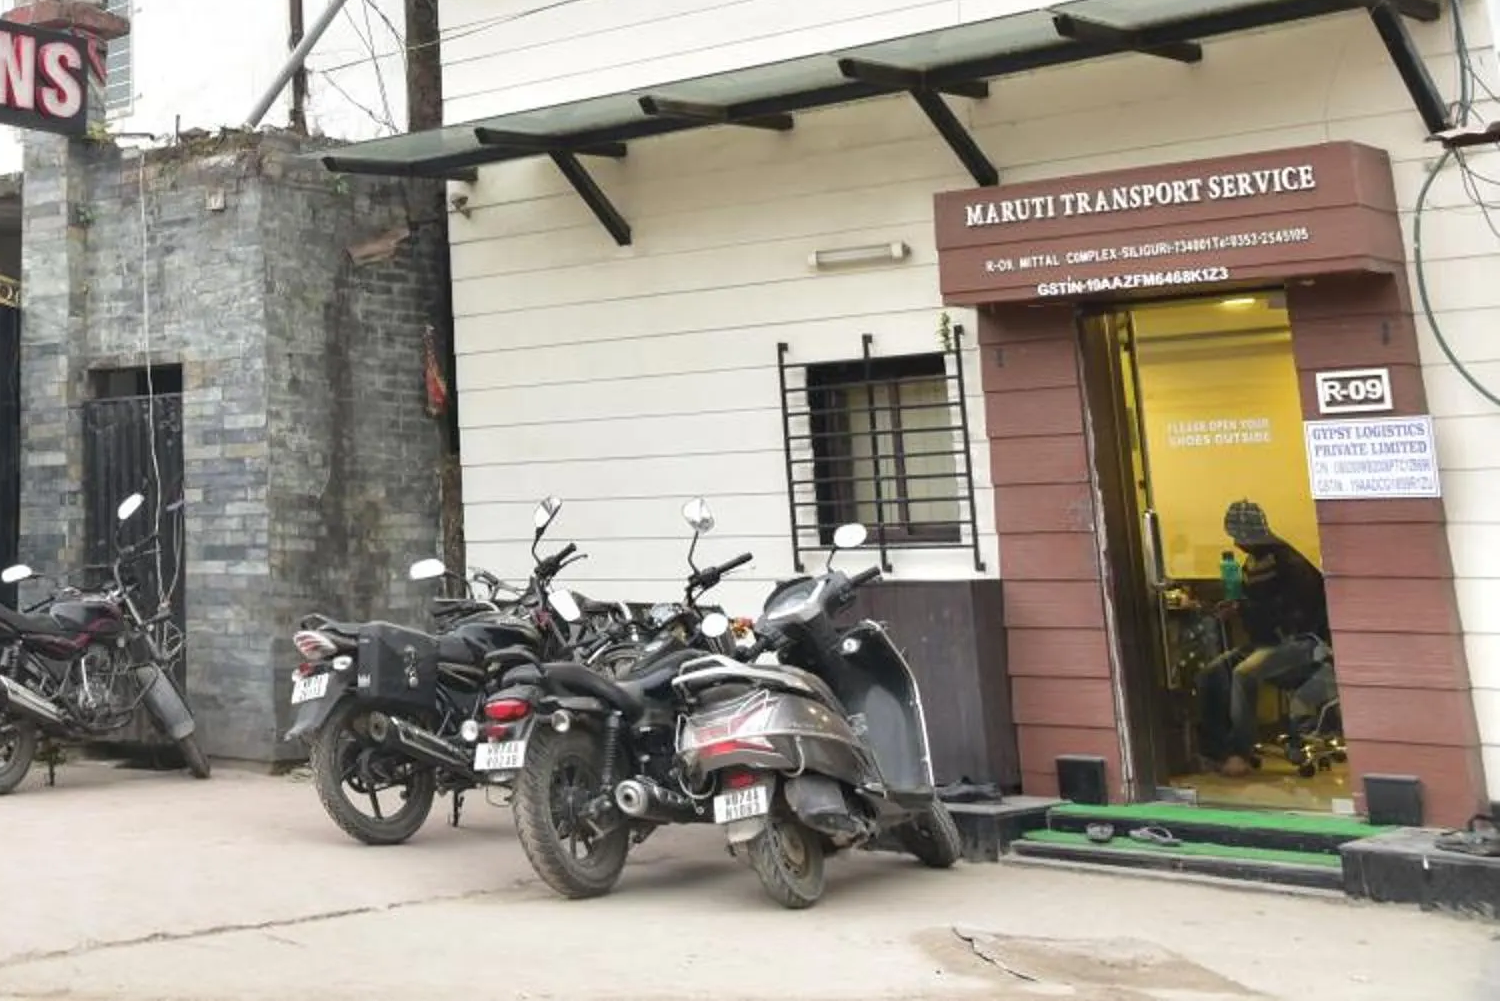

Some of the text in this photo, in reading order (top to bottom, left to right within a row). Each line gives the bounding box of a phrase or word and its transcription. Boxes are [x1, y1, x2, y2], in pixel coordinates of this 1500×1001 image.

[965, 165, 1316, 227] MARUTI TRANSPORT SERVICE
[1019, 255, 1060, 268] MITTAL
[1323, 379, 1383, 402] R-09
[1312, 423, 1425, 441] GYPSY LOGISTICS
[1314, 440, 1427, 457] PRIVATE LIMITED
